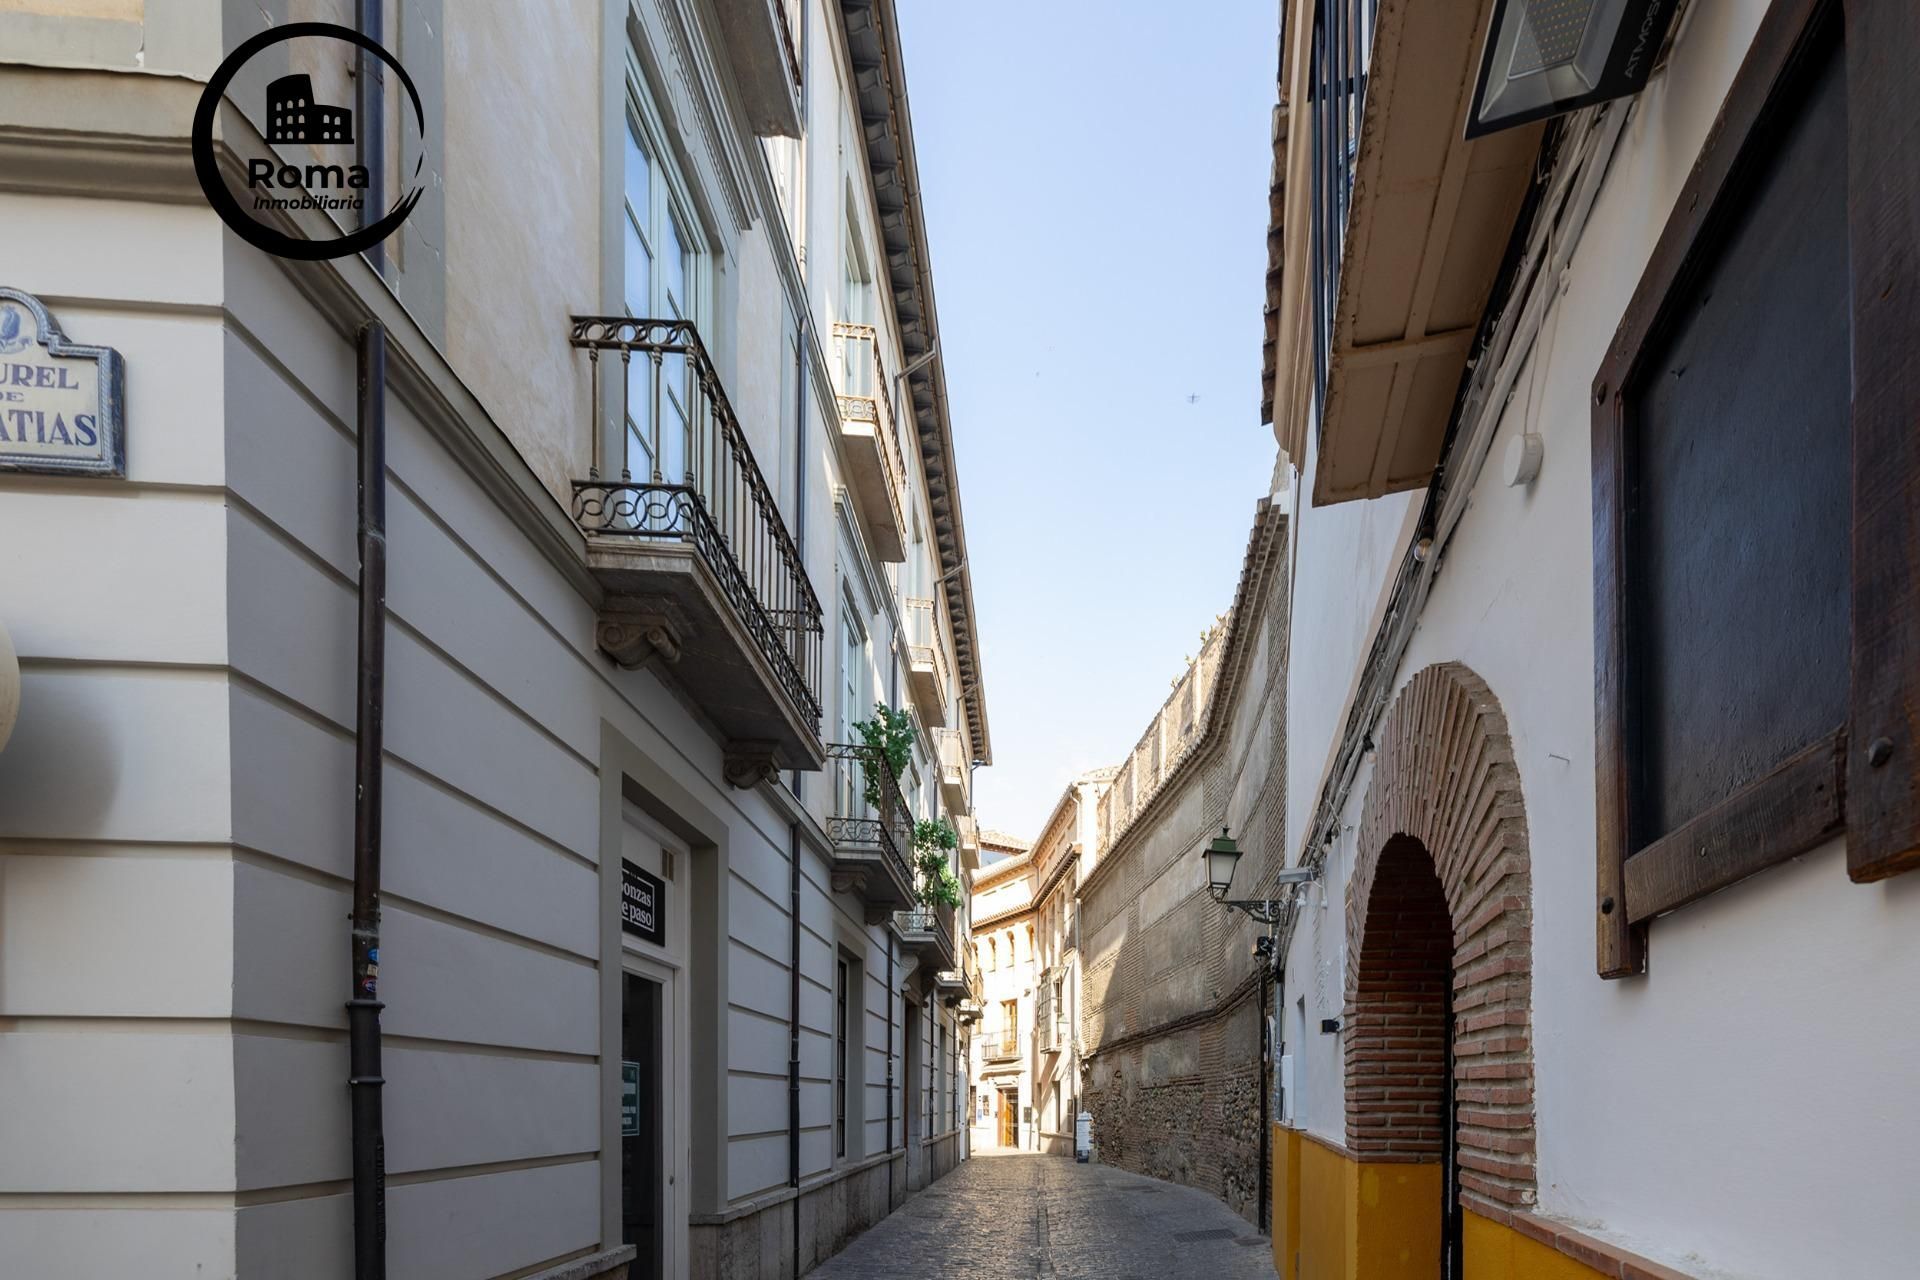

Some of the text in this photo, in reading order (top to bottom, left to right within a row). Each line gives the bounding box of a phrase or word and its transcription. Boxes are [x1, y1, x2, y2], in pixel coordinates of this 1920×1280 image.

[1624, 0, 1661, 79] ATMOS
[622, 882, 652, 907] onzas
[629, 904, 652, 926] paso
